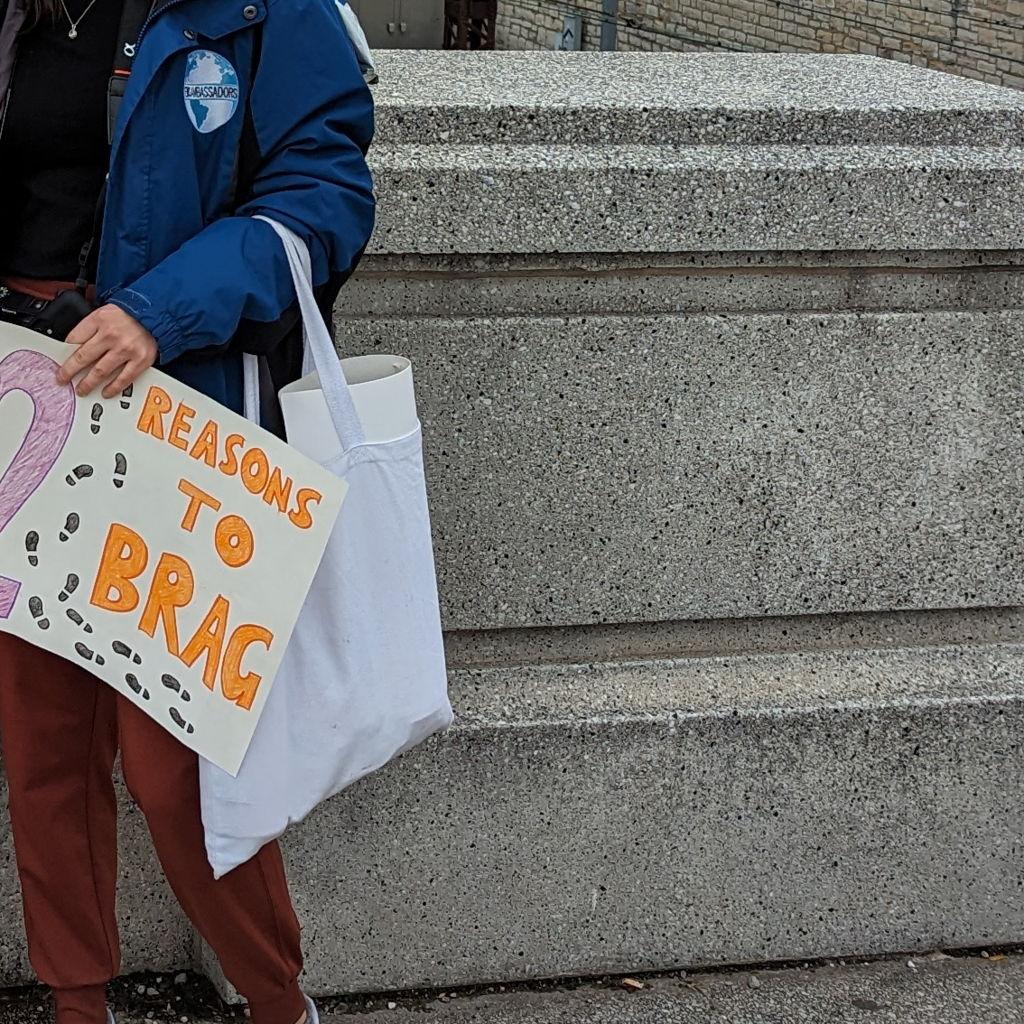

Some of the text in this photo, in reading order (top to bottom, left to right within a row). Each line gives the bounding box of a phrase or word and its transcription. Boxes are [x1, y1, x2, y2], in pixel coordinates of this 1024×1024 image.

[137, 385, 322, 530] REASONS
[178, 478, 255, 568] TO
[90, 523, 274, 712] BRAG
